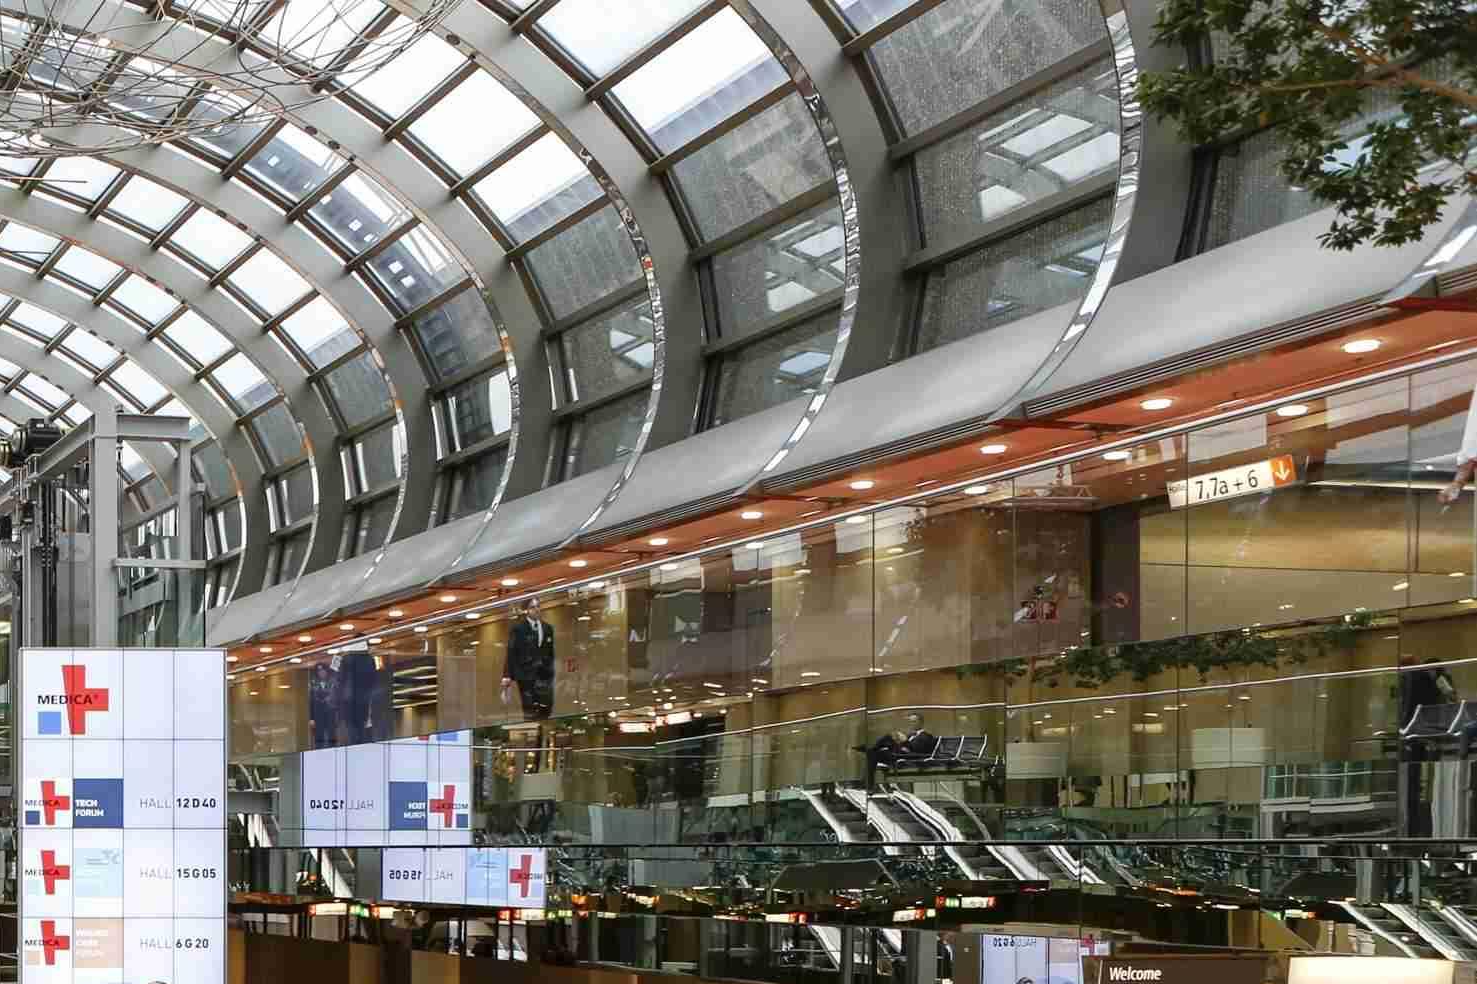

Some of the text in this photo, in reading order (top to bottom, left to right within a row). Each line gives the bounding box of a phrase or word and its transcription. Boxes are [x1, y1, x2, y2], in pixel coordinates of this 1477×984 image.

[1195, 477, 1229, 500] 7,7a
[1248, 469, 1259, 488] 6
[140, 798, 172, 808] HALL
[75, 808, 105, 817] FORUM
[140, 868, 172, 879] HALL
[140, 938, 172, 949] HALL
[1109, 966, 1163, 981] Welcome
